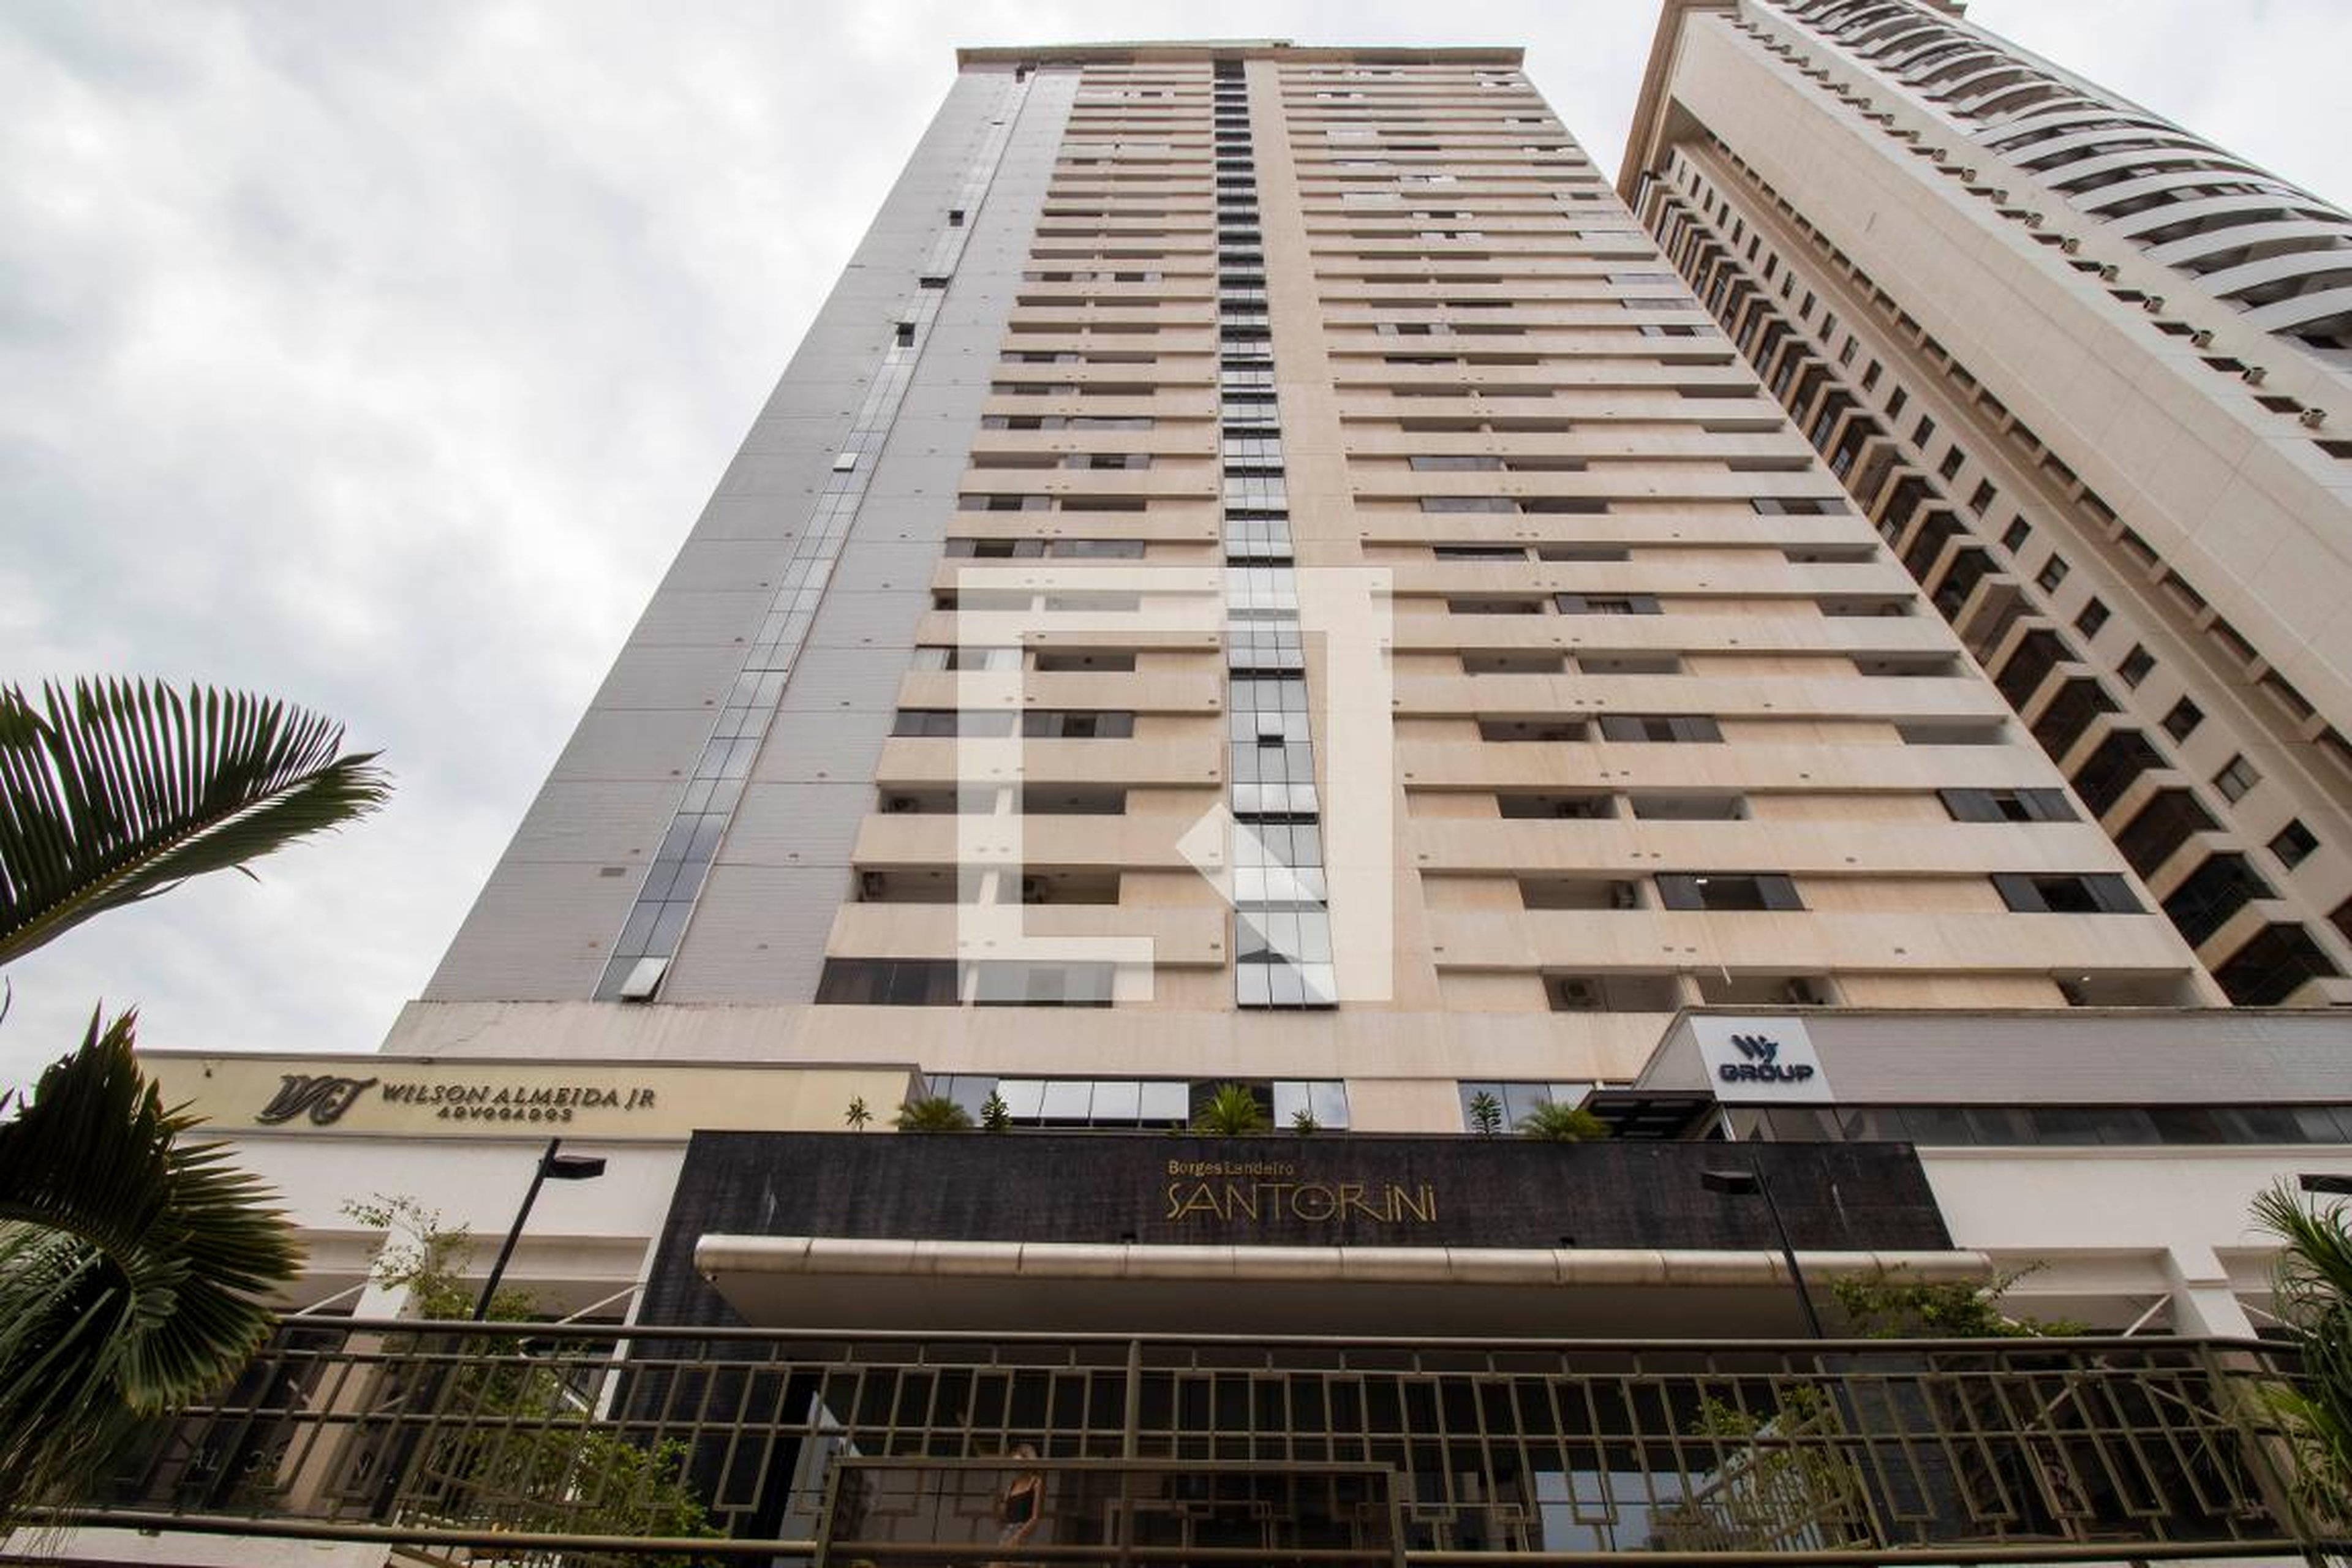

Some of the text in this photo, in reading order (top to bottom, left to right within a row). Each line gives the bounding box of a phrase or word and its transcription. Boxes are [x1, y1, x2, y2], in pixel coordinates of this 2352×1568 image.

[1719, 1064, 1814, 1083] GROUP
[381, 1083, 655, 1112] WILSON ALMEIDA JR
[437, 1105, 573, 1123] ADVOGADOS
[1168, 1159, 1222, 1177] Borges
